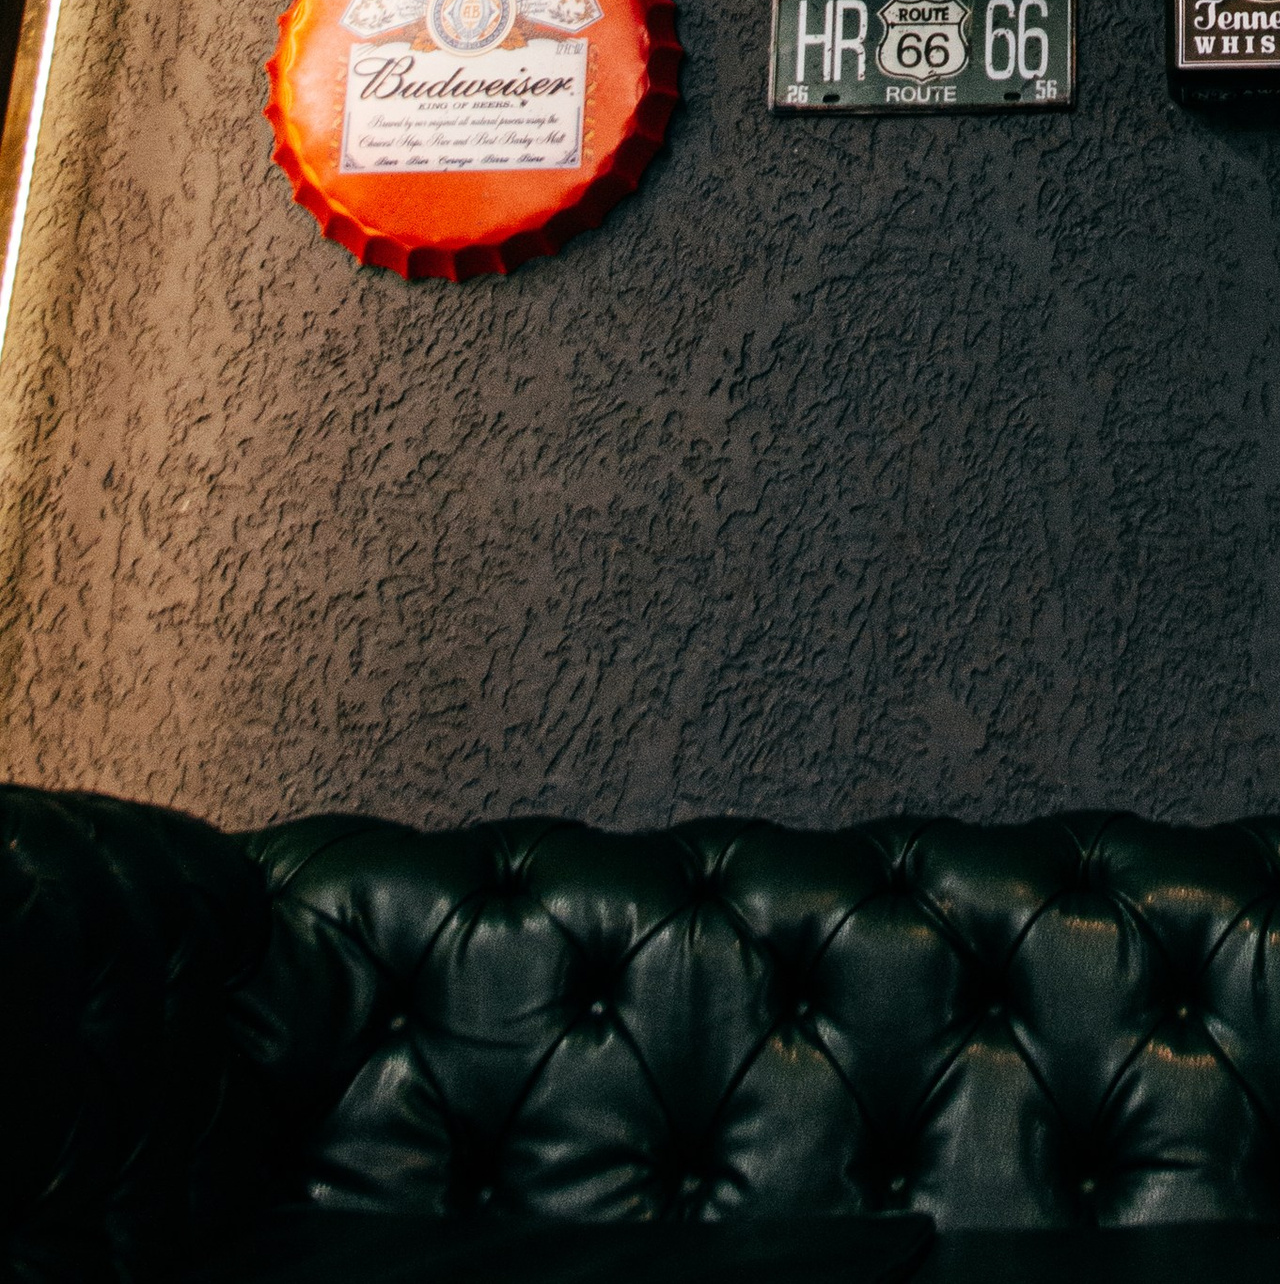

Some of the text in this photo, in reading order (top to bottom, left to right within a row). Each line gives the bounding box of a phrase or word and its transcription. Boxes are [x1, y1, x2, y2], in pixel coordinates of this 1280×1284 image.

[898, 6, 950, 22] ROUTE
[896, 32, 950, 69] 66
[353, 55, 573, 100] Budweiser
[886, 85, 957, 102] ROUTE
[417, 100, 448, 110] KING
[452, 100, 468, 110] OF
